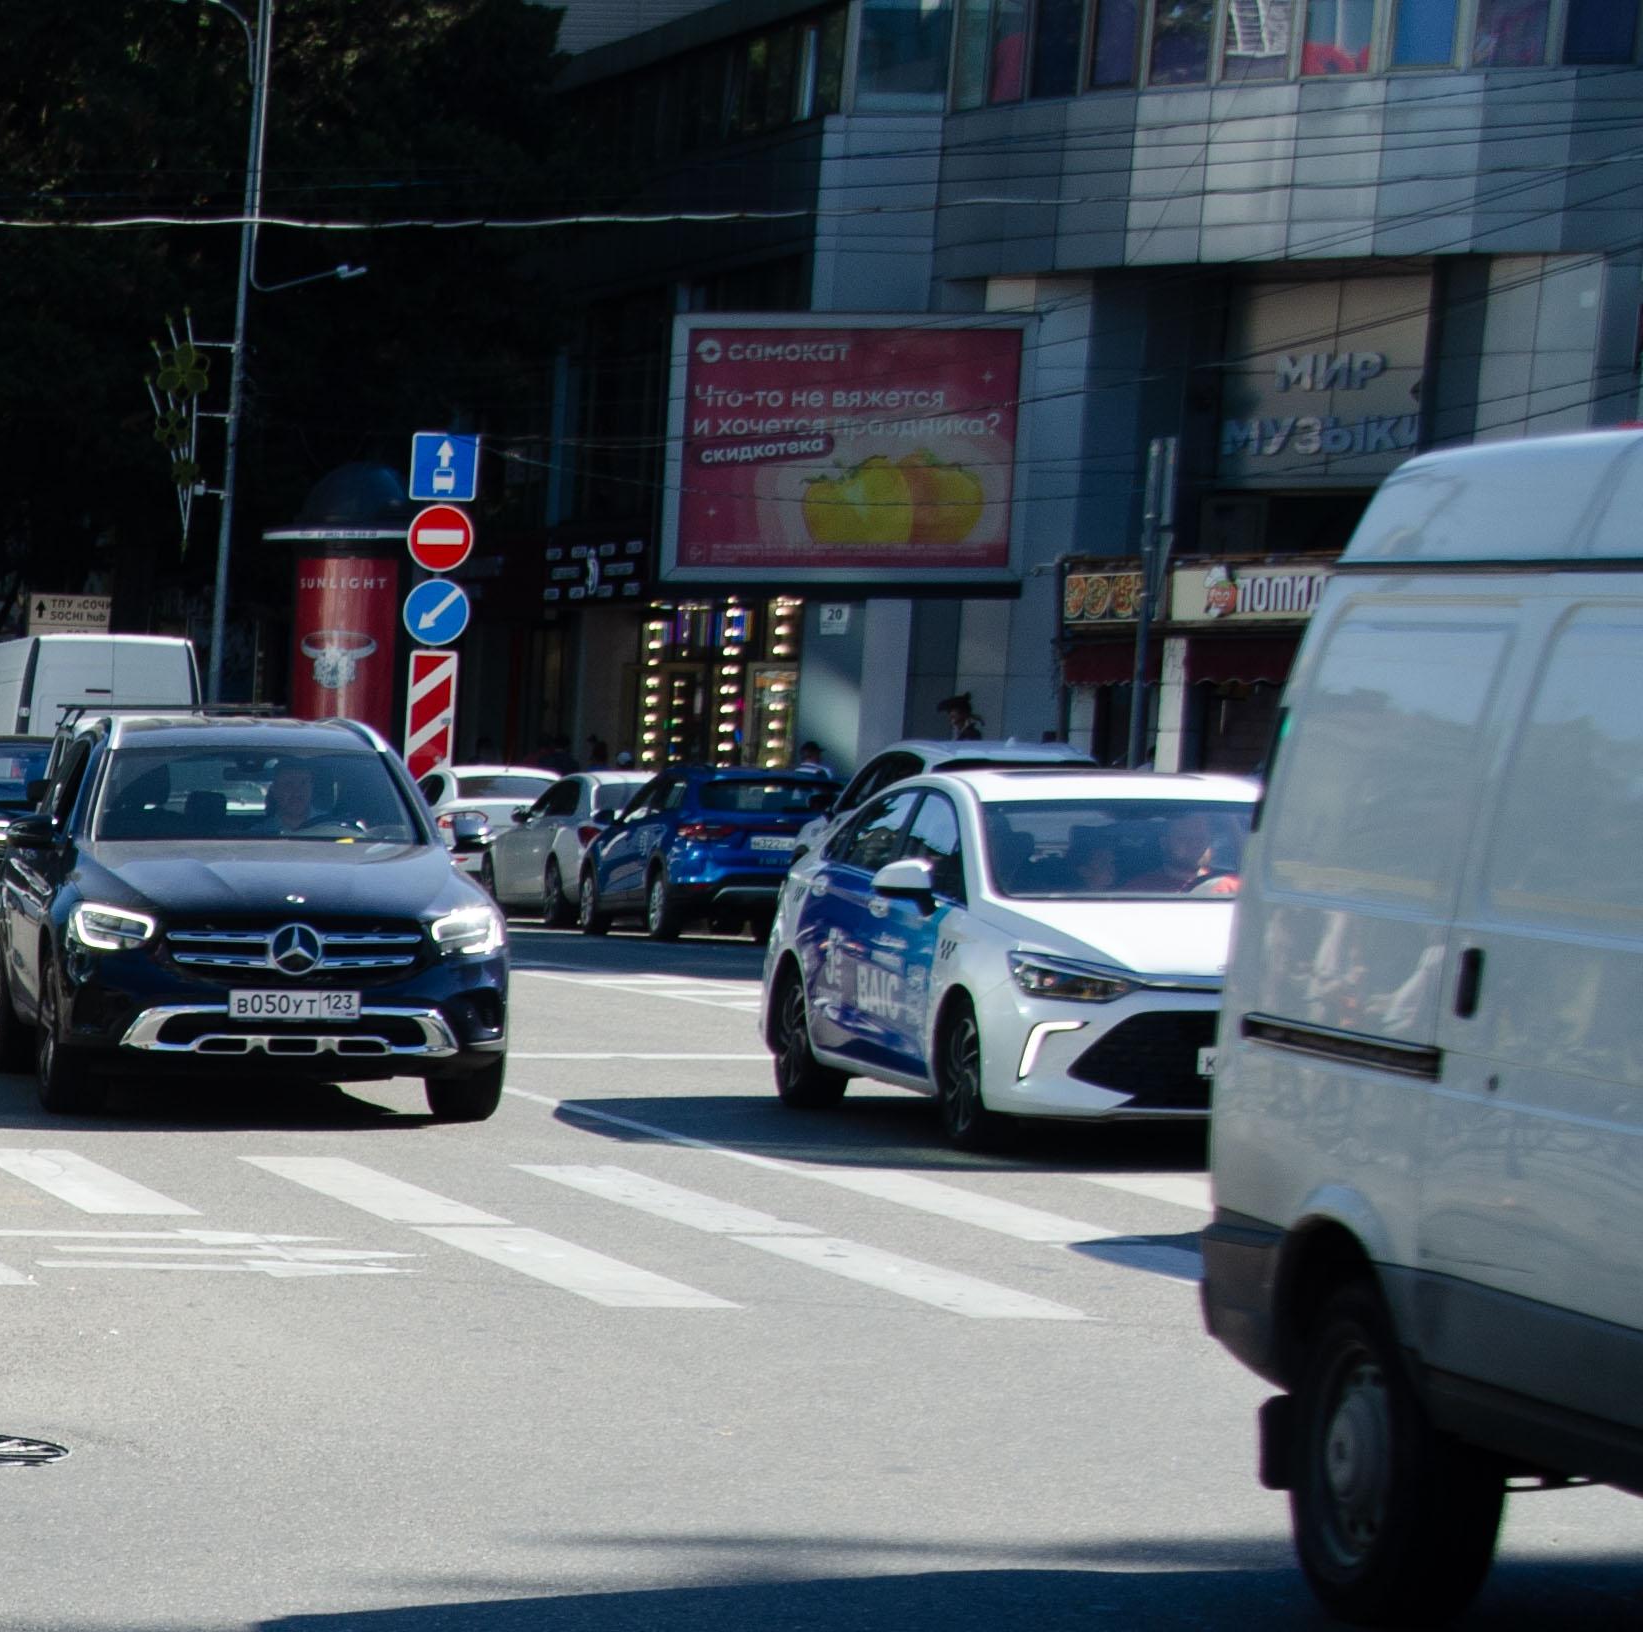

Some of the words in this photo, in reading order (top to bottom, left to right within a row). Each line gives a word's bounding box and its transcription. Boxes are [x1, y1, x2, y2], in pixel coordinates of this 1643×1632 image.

[728, 342, 850, 361] самокат
[1275, 352, 1385, 392] МИР
[695, 384, 784, 408] Что-то
[791, 390, 824, 408] не
[832, 390, 945, 409] вяжется
[717, 416, 826, 436] хочется
[833, 412, 1001, 441] праздника?
[701, 437, 825, 464] скидкотека
[300, 577, 387, 589] SUNLIGHT
[50, 611, 83, 621] SOCHI
[86, 612, 106, 622] hub
[827, 608, 843, 621] 20
[237, 994, 317, 1014] В050УТ
[323, 994, 353, 1010] 123
